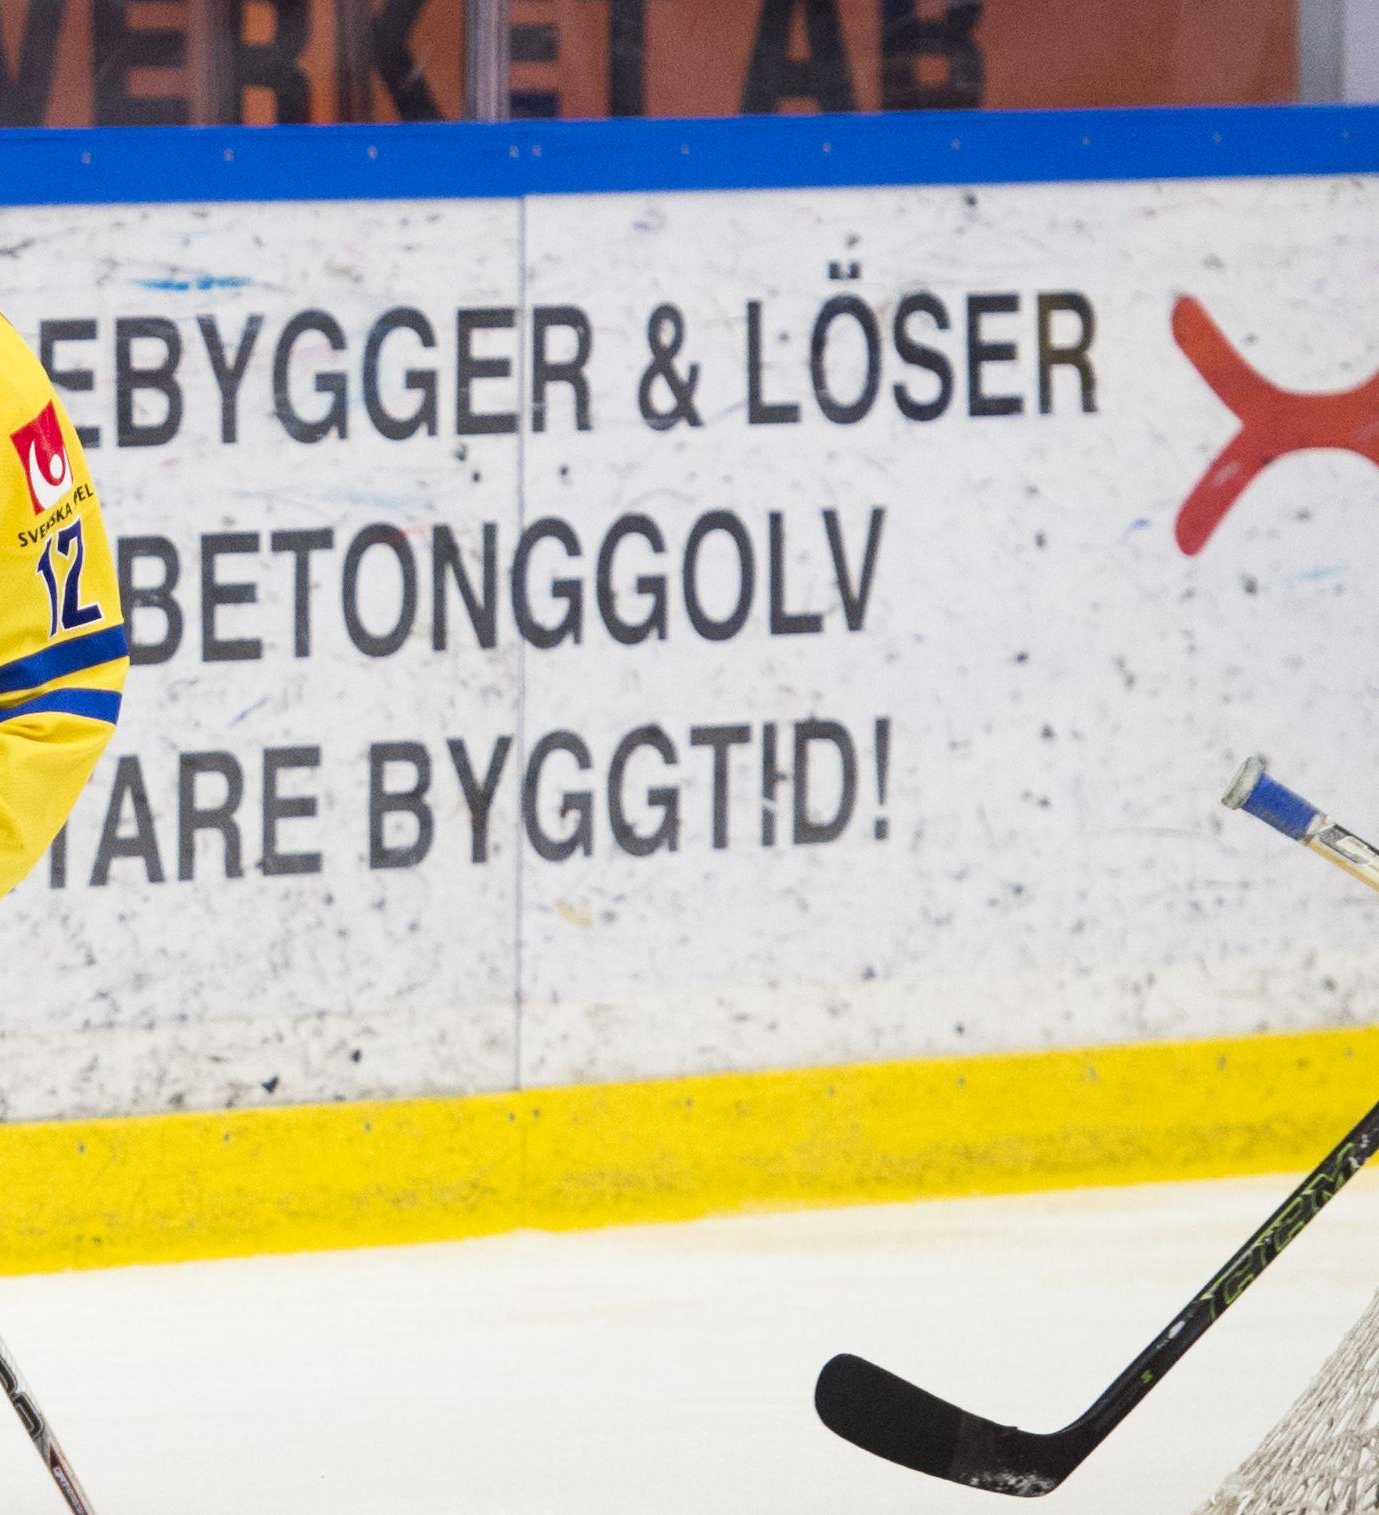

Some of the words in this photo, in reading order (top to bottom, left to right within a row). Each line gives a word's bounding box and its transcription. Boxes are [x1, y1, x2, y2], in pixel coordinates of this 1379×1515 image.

[638, 304, 704, 431] &
[747, 262, 1098, 425] LÖSER
[37, 517, 104, 638] 12
[117, 507, 886, 666] BETONGGOLV
[370, 717, 891, 870] BYGGTID!
